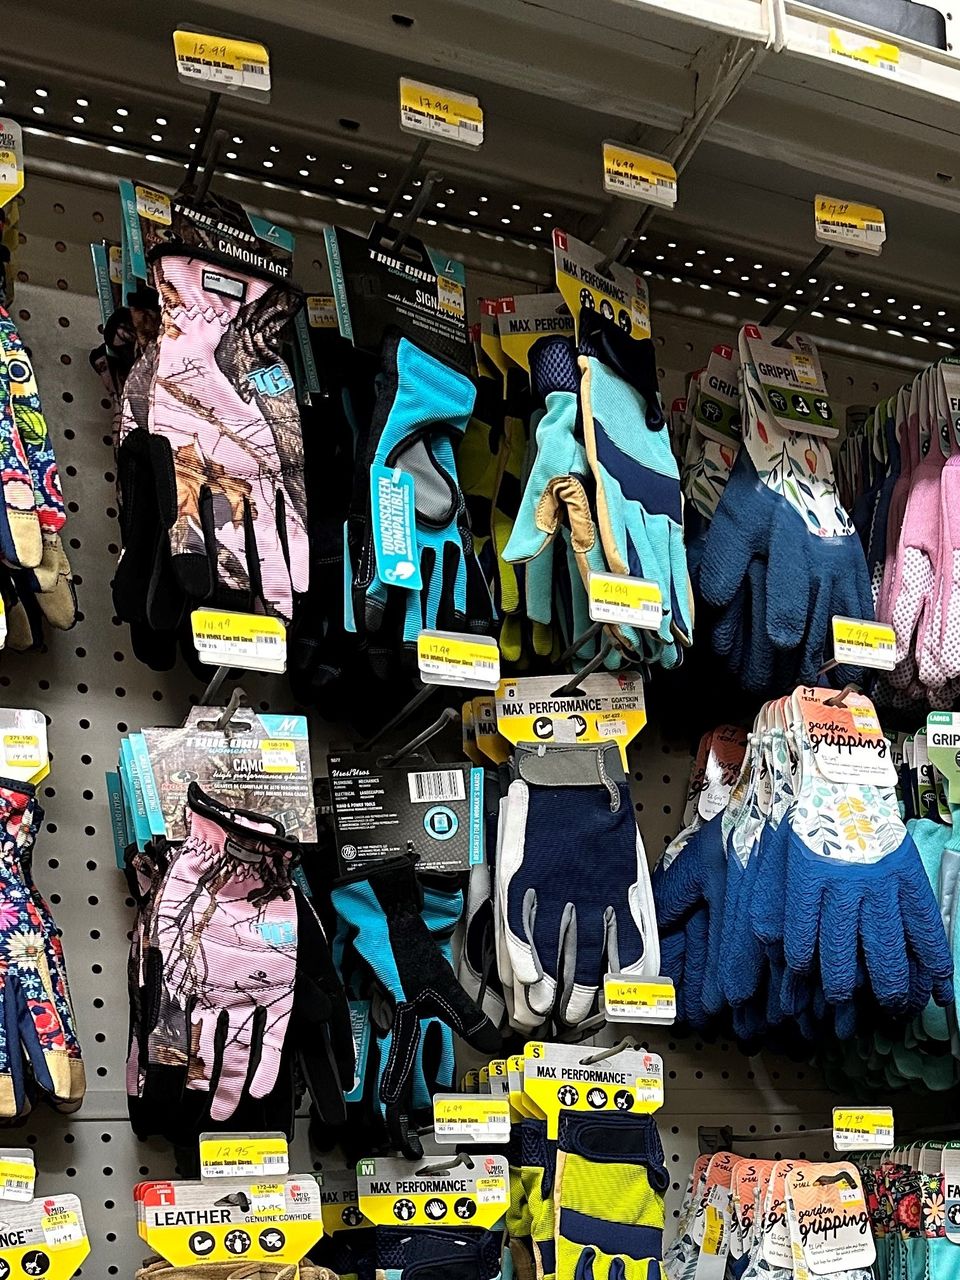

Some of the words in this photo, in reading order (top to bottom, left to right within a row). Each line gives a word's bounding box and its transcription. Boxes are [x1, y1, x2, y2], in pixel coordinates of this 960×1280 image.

[174, 204, 215, 226] TRUE
[216, 221, 256, 243] GRIP
[368, 249, 403, 269] TRUE
[404, 267, 437, 283] GRIP
[562, 258, 578, 278] MAX
[509, 320, 531, 333] MAX
[378, 477, 395, 555] TOUCHSCREEN
[391, 485, 407, 555] COMPATIBLE
[508, 689, 516, 698] 8
[803, 688, 815, 697] M
[611, 696, 639, 704] GOATSKIN
[503, 704, 525, 716] MAX
[277, 717, 299, 731] M
[808, 720, 849, 734] garden
[809, 730, 887, 759] gripping
[532, 1048, 541, 1058] S
[495, 1065, 503, 1076] S
[537, 1066, 556, 1078] MAX
[721, 1155, 731, 1164] S
[361, 1165, 375, 1176] M
[748, 1165, 756, 1176] S
[785, 1163, 794, 1173] S
[796, 1171, 805, 1182] S
[370, 1182, 392, 1193] MAX
[155, 1210, 232, 1227] LEATHER
[245, 1215, 277, 1223] GENUINE
[279, 1212, 312, 1221] COWHIDE
[798, 1204, 835, 1223] garden
[799, 1210, 870, 1248] gripping
